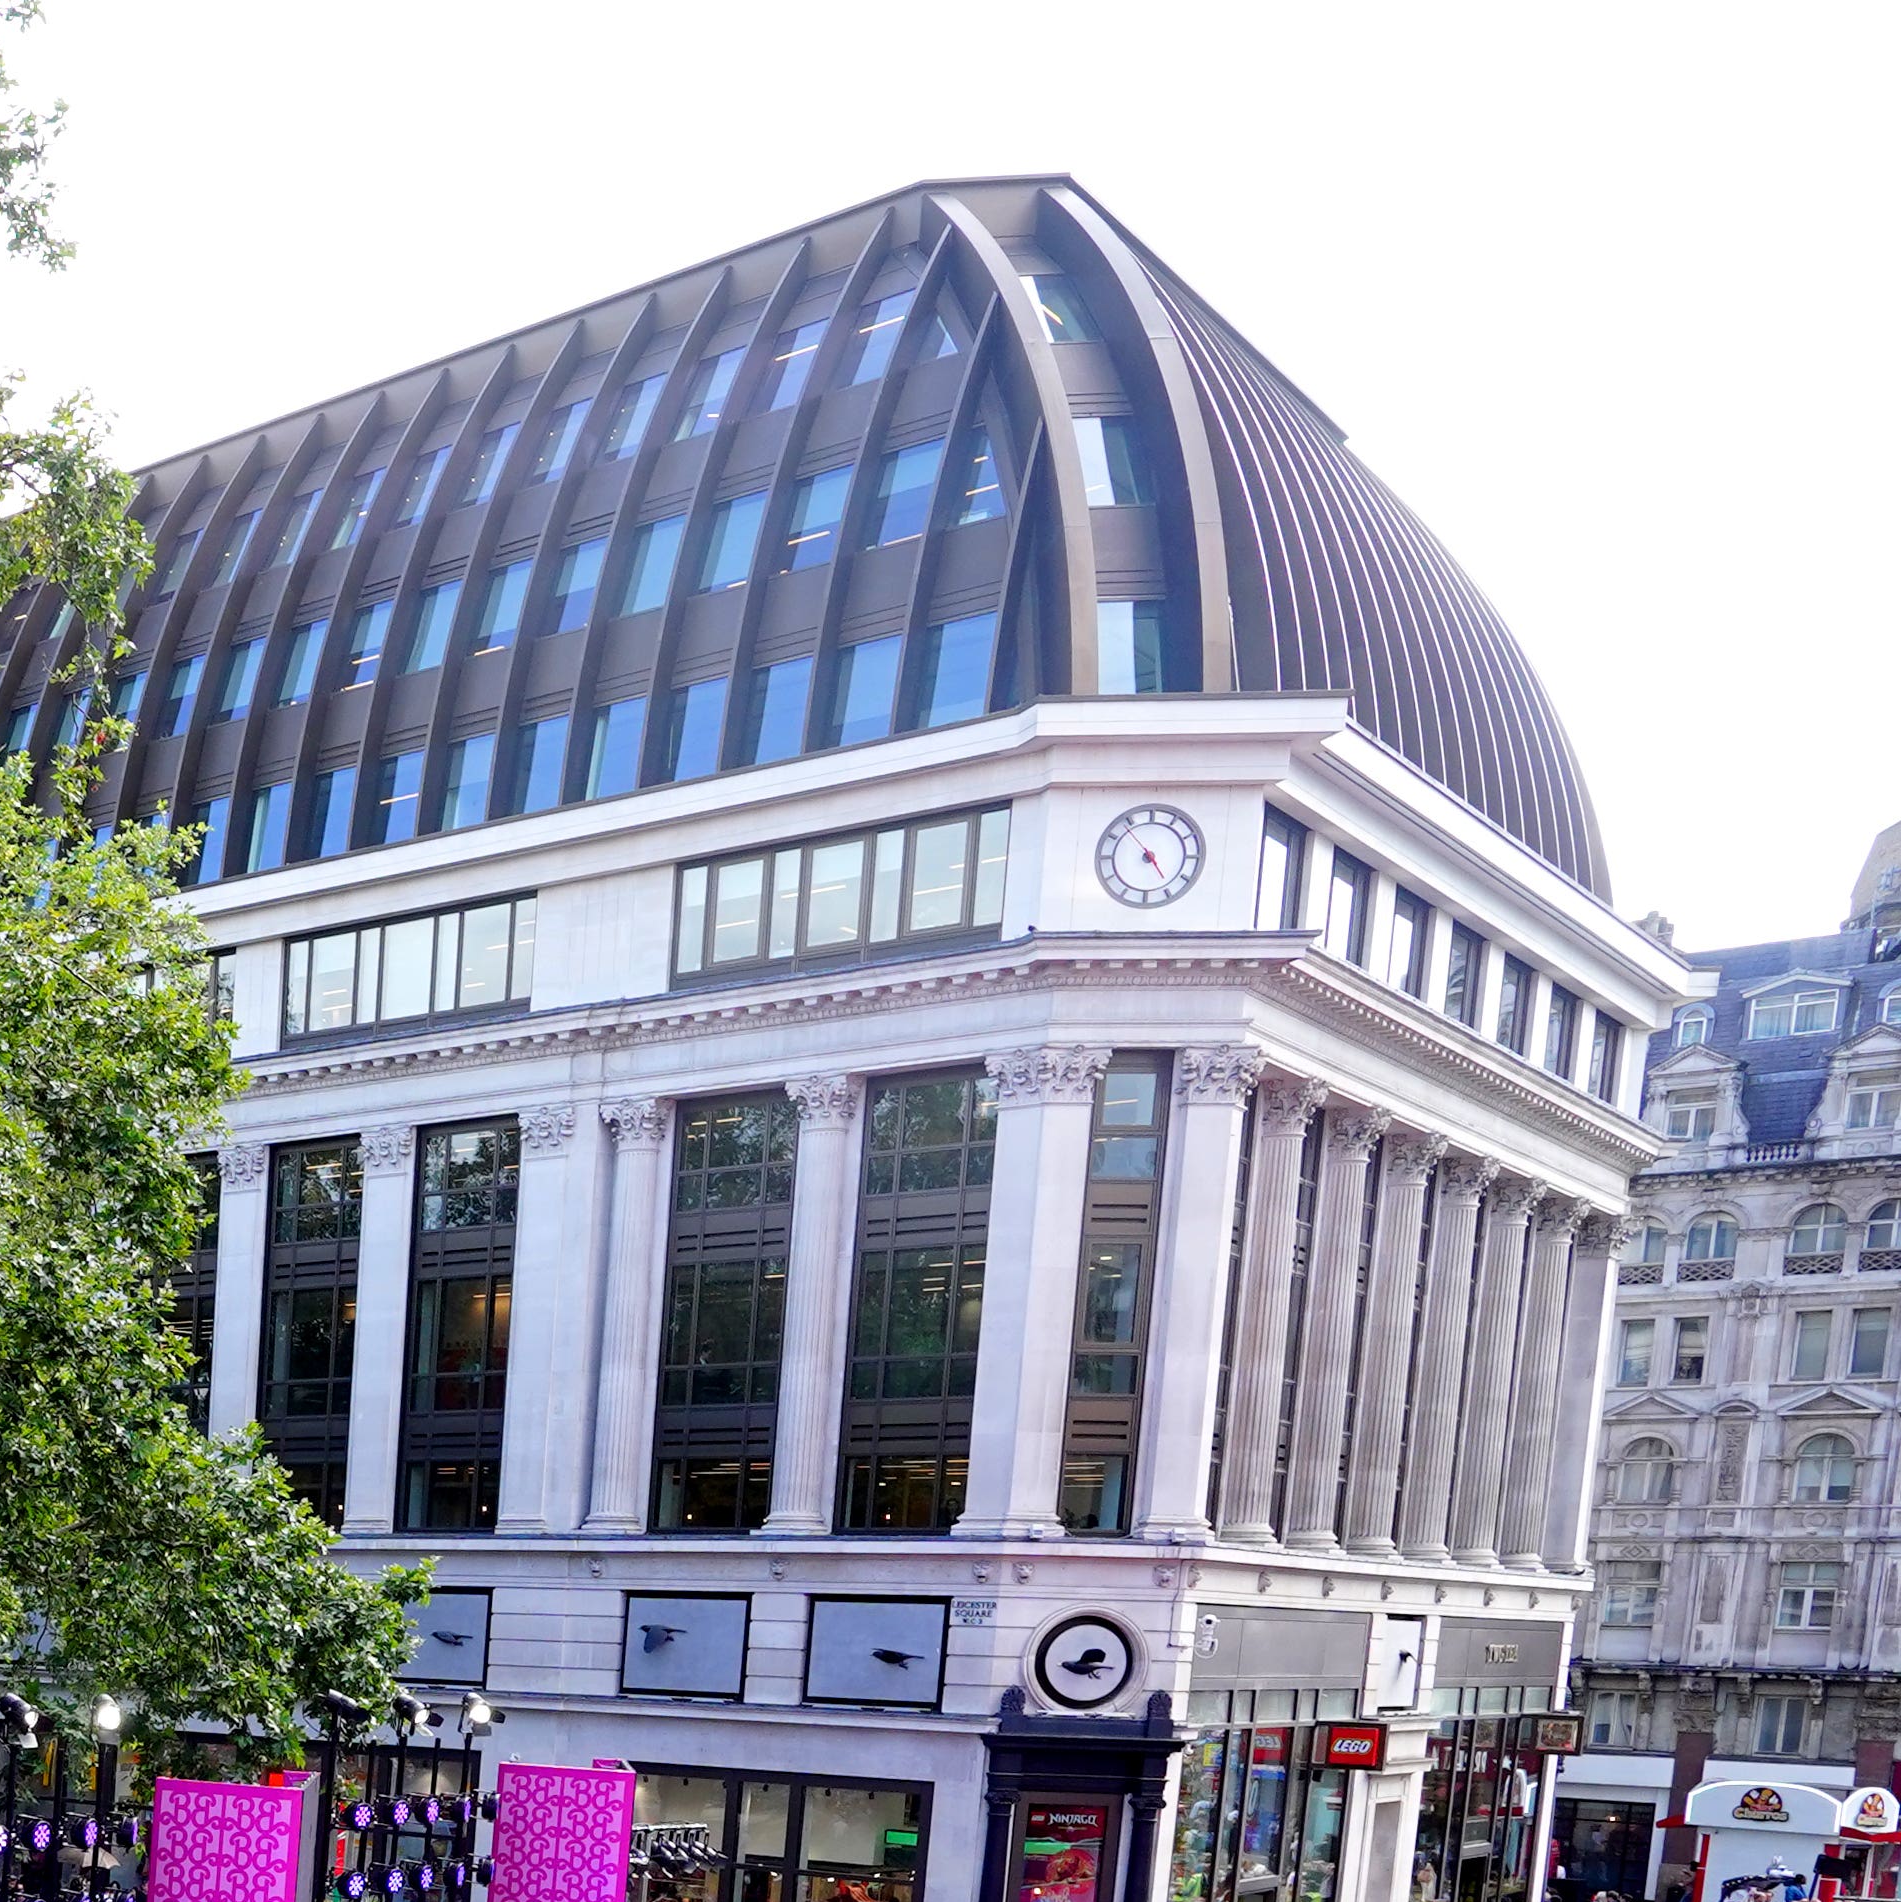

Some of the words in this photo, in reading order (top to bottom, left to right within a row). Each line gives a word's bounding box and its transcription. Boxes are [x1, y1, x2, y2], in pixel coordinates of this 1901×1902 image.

[952, 1600, 997, 1609] LEICESTER
[955, 1609, 993, 1618] SQUARE
[1333, 1738, 1373, 1754] LEGO
[1047, 1813, 1099, 1828] NINJAGO
